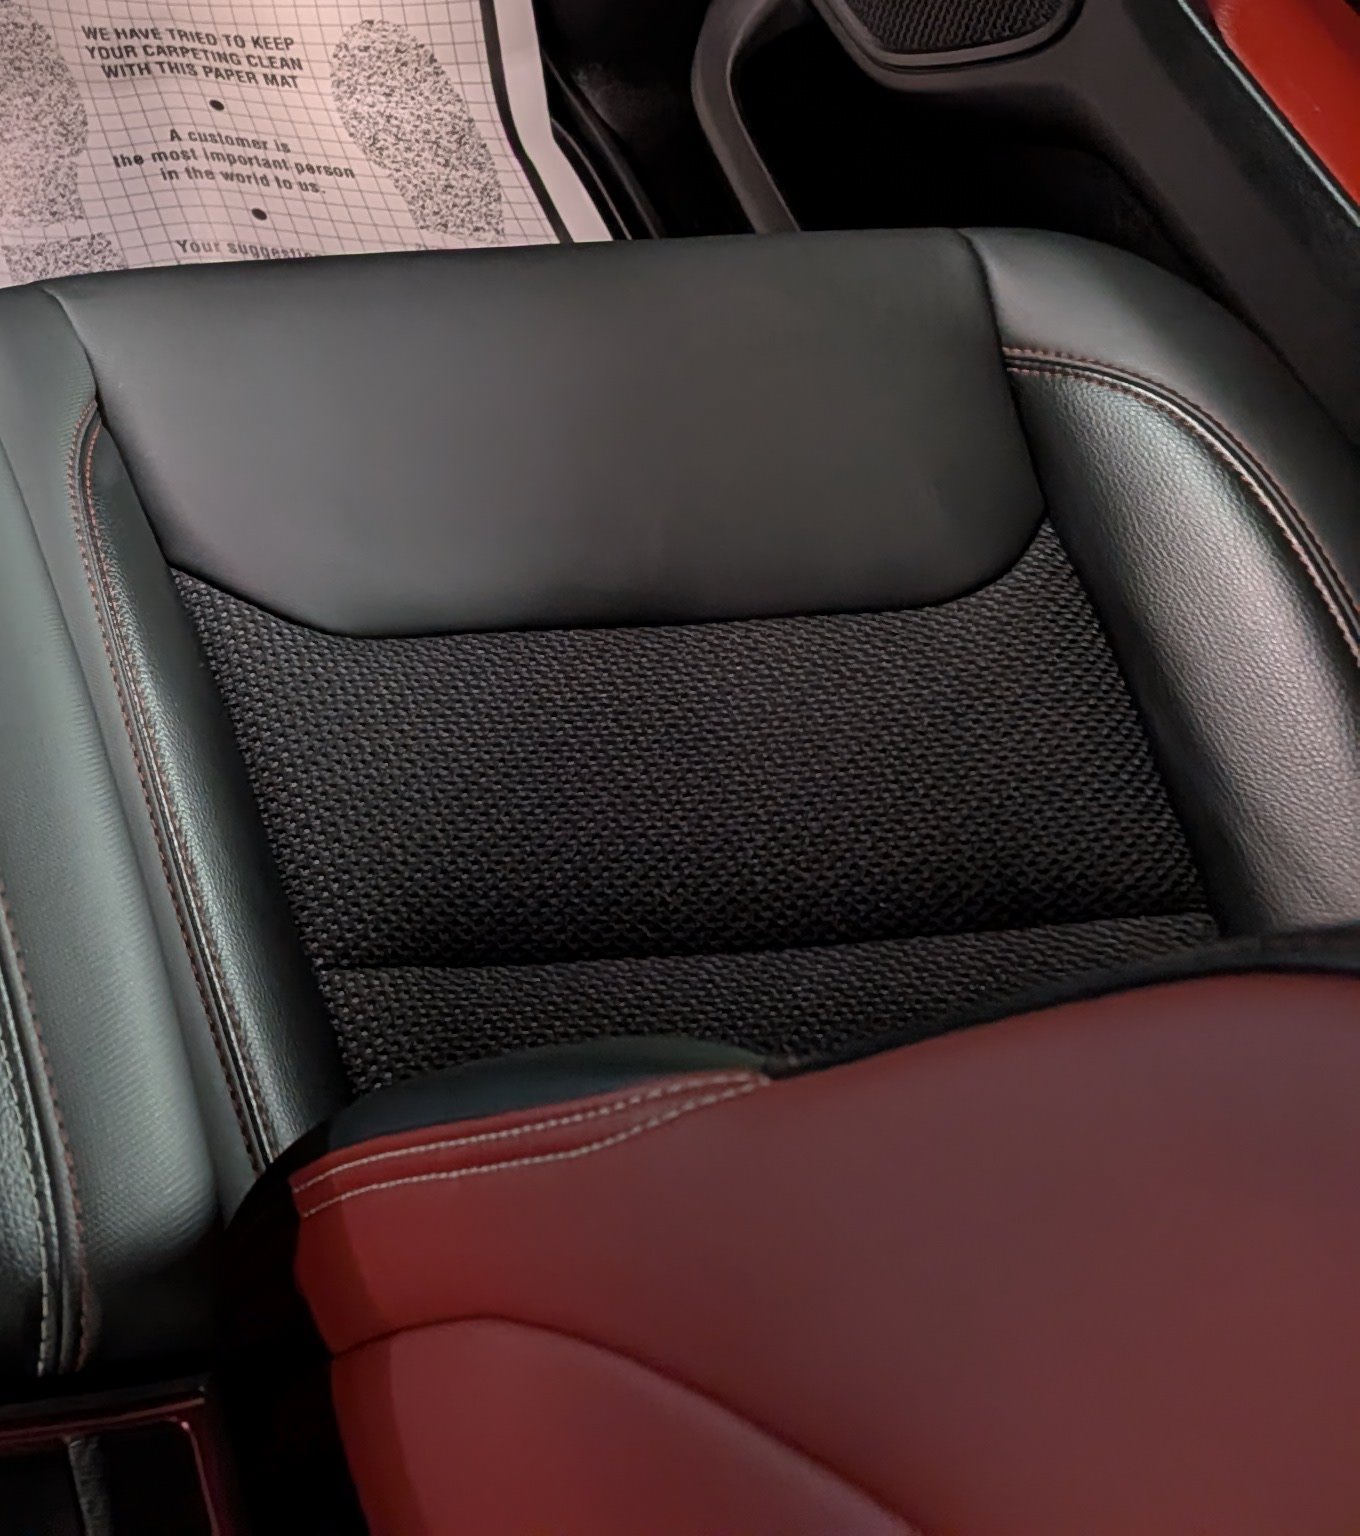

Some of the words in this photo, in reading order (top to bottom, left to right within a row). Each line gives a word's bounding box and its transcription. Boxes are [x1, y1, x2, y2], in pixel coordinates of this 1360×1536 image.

[81, 25, 111, 42] WE
[114, 27, 163, 41] HAVE
[165, 28, 218, 47] TRIED
[221, 33, 246, 50] TO
[250, 35, 295, 52] KEEP
[85, 44, 139, 60] YOUR
[143, 44, 242, 66] CARPETING
[246, 54, 304, 72] CLEAN
[101, 62, 152, 80] WITH
[156, 61, 199, 77] THIS
[203, 66, 260, 86] PAPER
[262, 73, 300, 90] MAT
[168, 128, 183, 143] A
[187, 130, 269, 151] customer
[275, 138, 292, 155] is
[112, 153, 145, 169] the
[151, 147, 198, 163] most
[204, 147, 290, 172] important
[295, 161, 356, 180] person
[160, 167, 180, 182] in
[185, 166, 216, 181] the
[222, 169, 271, 188] world
[276, 175, 294, 191] to
[298, 180, 327, 195] us.
[175, 239, 221, 255] Your
